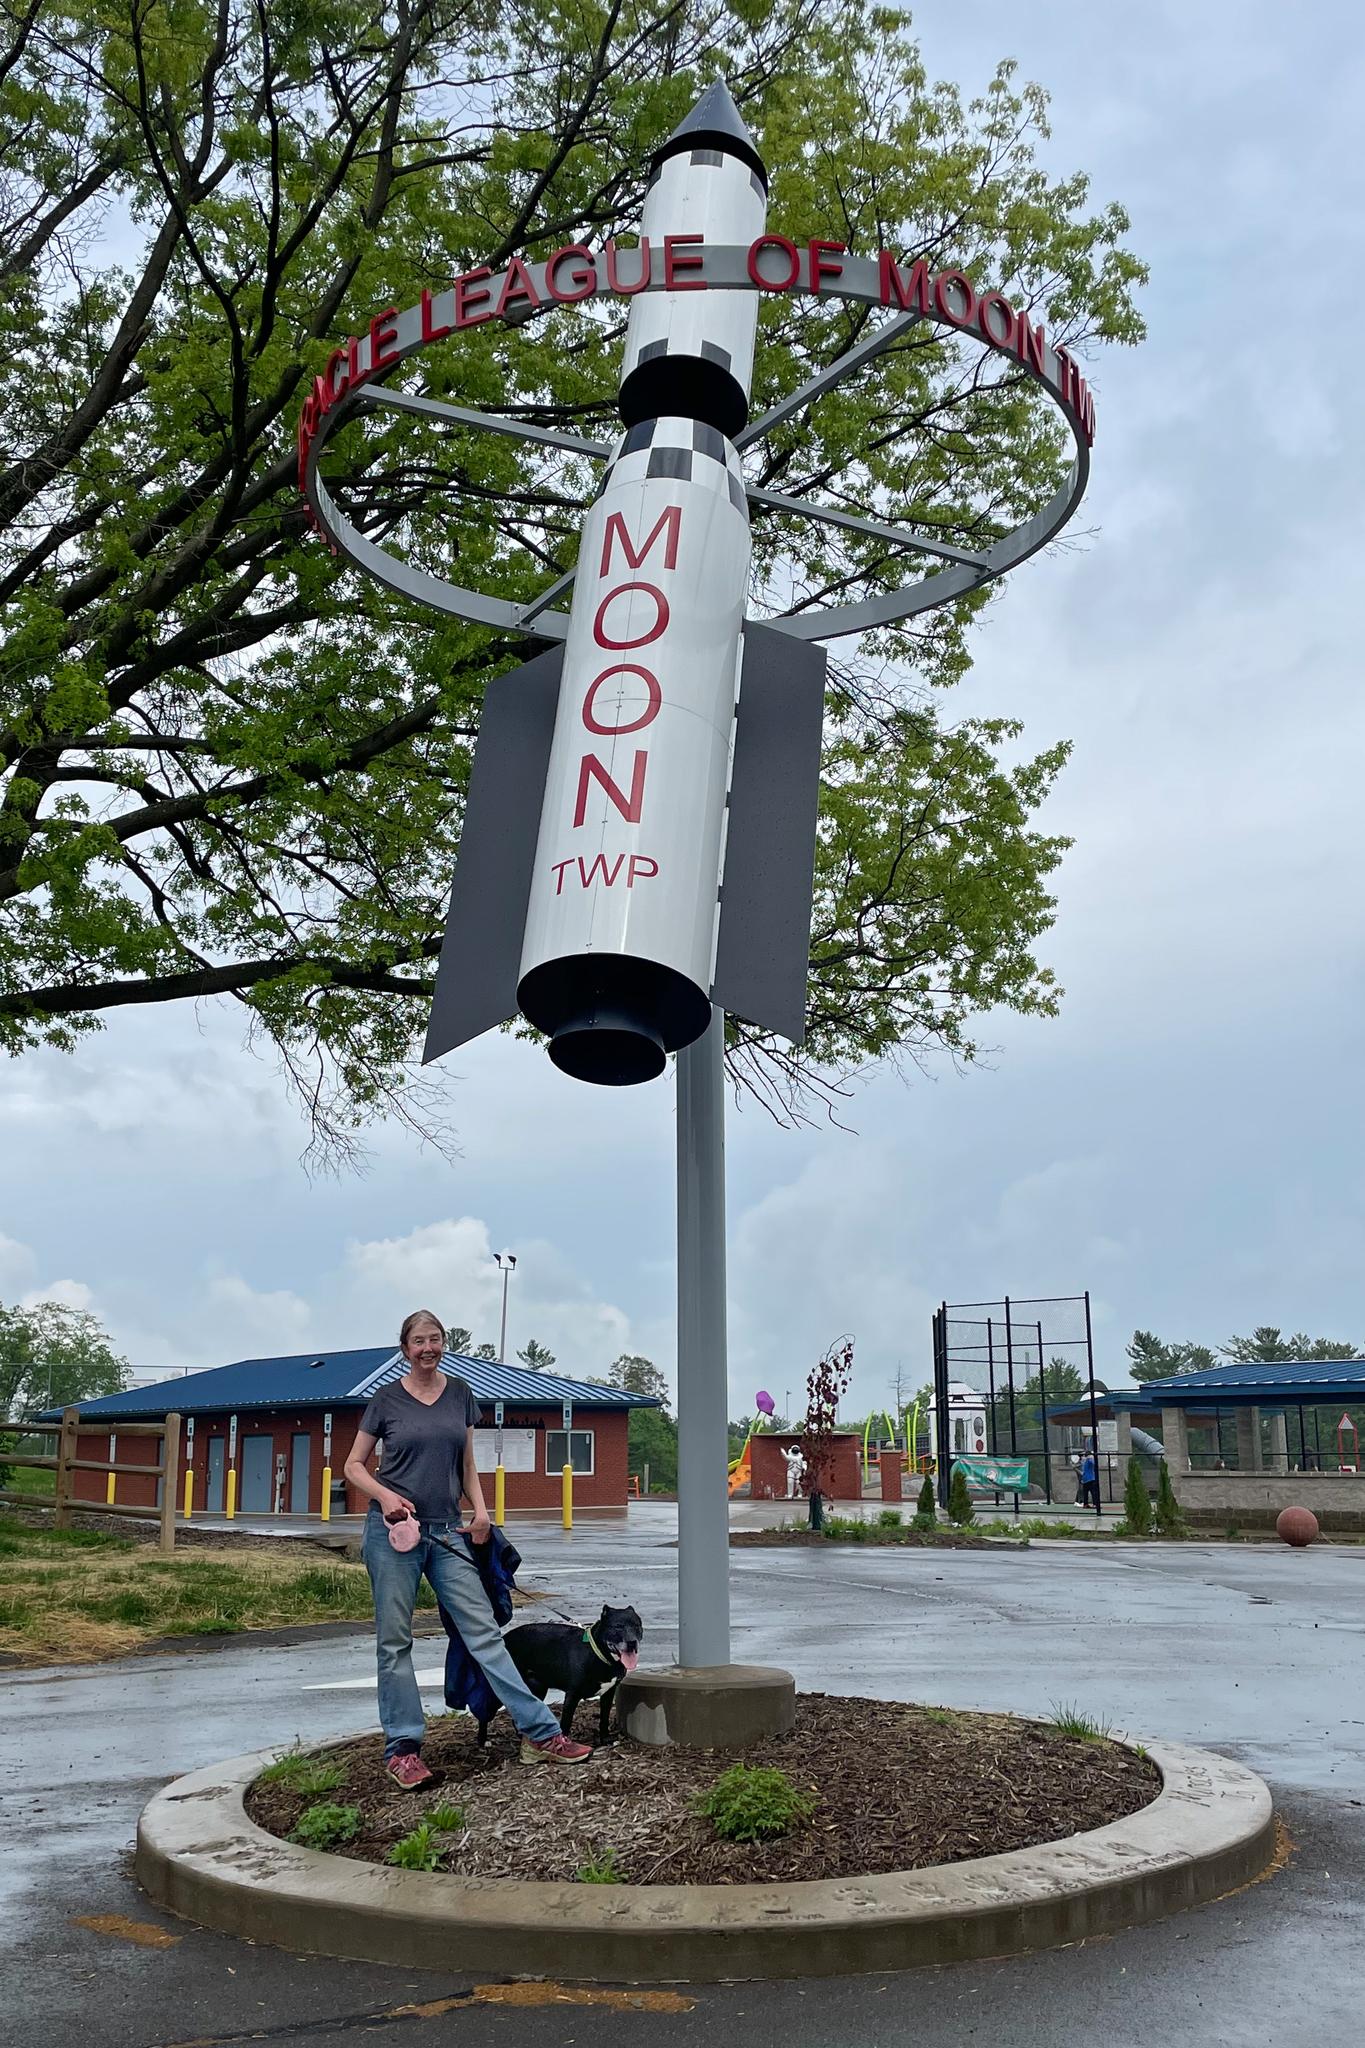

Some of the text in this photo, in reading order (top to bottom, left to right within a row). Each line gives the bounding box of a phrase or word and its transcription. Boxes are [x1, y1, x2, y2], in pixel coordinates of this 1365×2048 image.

[421, 234, 708, 343] LEAGUE
[747, 234, 845, 295] OF
[878, 250, 1045, 375] MOON
[1054, 345, 1097, 448] TW
[573, 505, 683, 829] MOON
[551, 853, 660, 896] TWP
